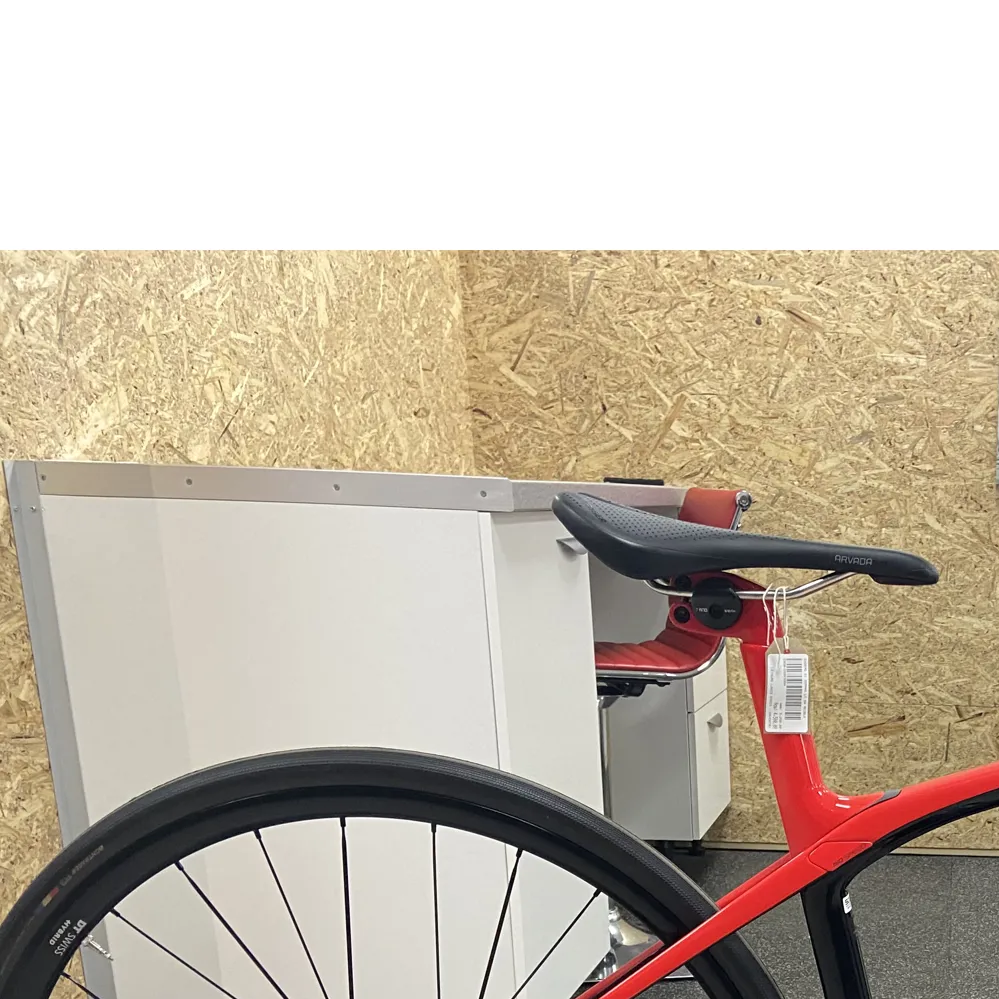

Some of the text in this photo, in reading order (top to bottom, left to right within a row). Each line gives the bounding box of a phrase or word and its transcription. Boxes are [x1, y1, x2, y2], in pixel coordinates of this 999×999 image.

[834, 554, 873, 566] ARVADA
[49, 919, 72, 946] HYBRID
[54, 919, 88, 957] DT SWISS
